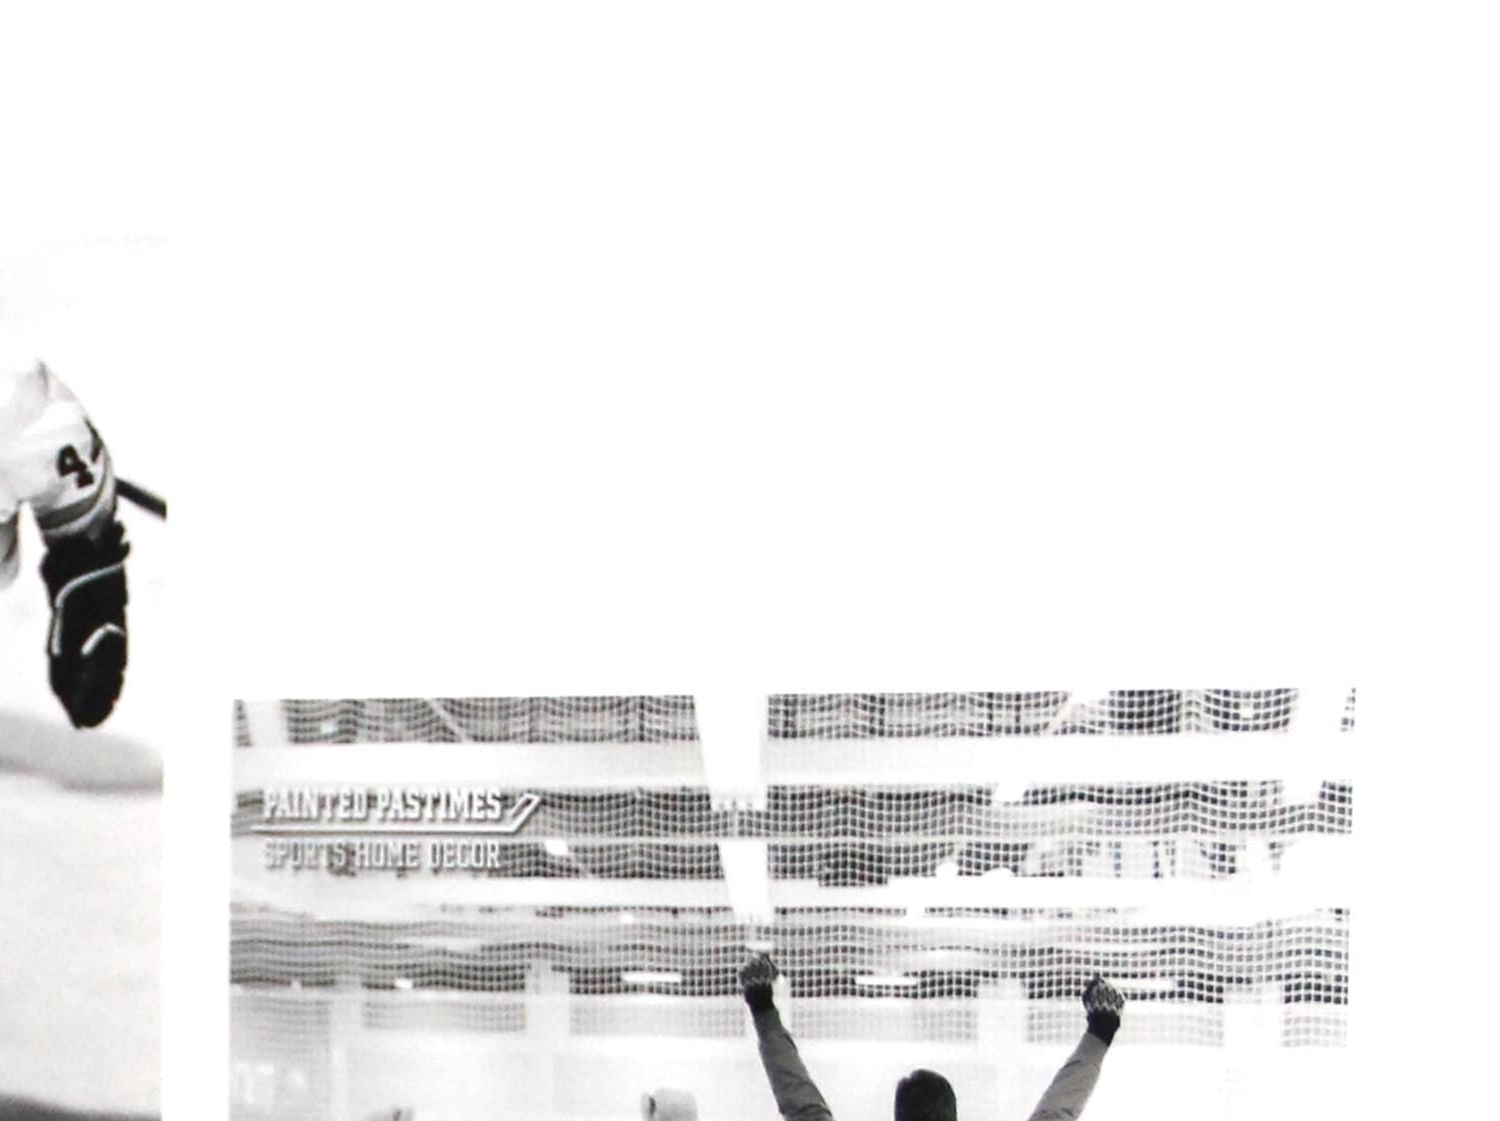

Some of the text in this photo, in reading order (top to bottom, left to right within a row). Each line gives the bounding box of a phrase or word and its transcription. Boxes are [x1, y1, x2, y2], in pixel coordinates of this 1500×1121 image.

[263, 787, 502, 820] PAINTED PASTIMES
[265, 839, 501, 868] SPORTS HOME DECOR
